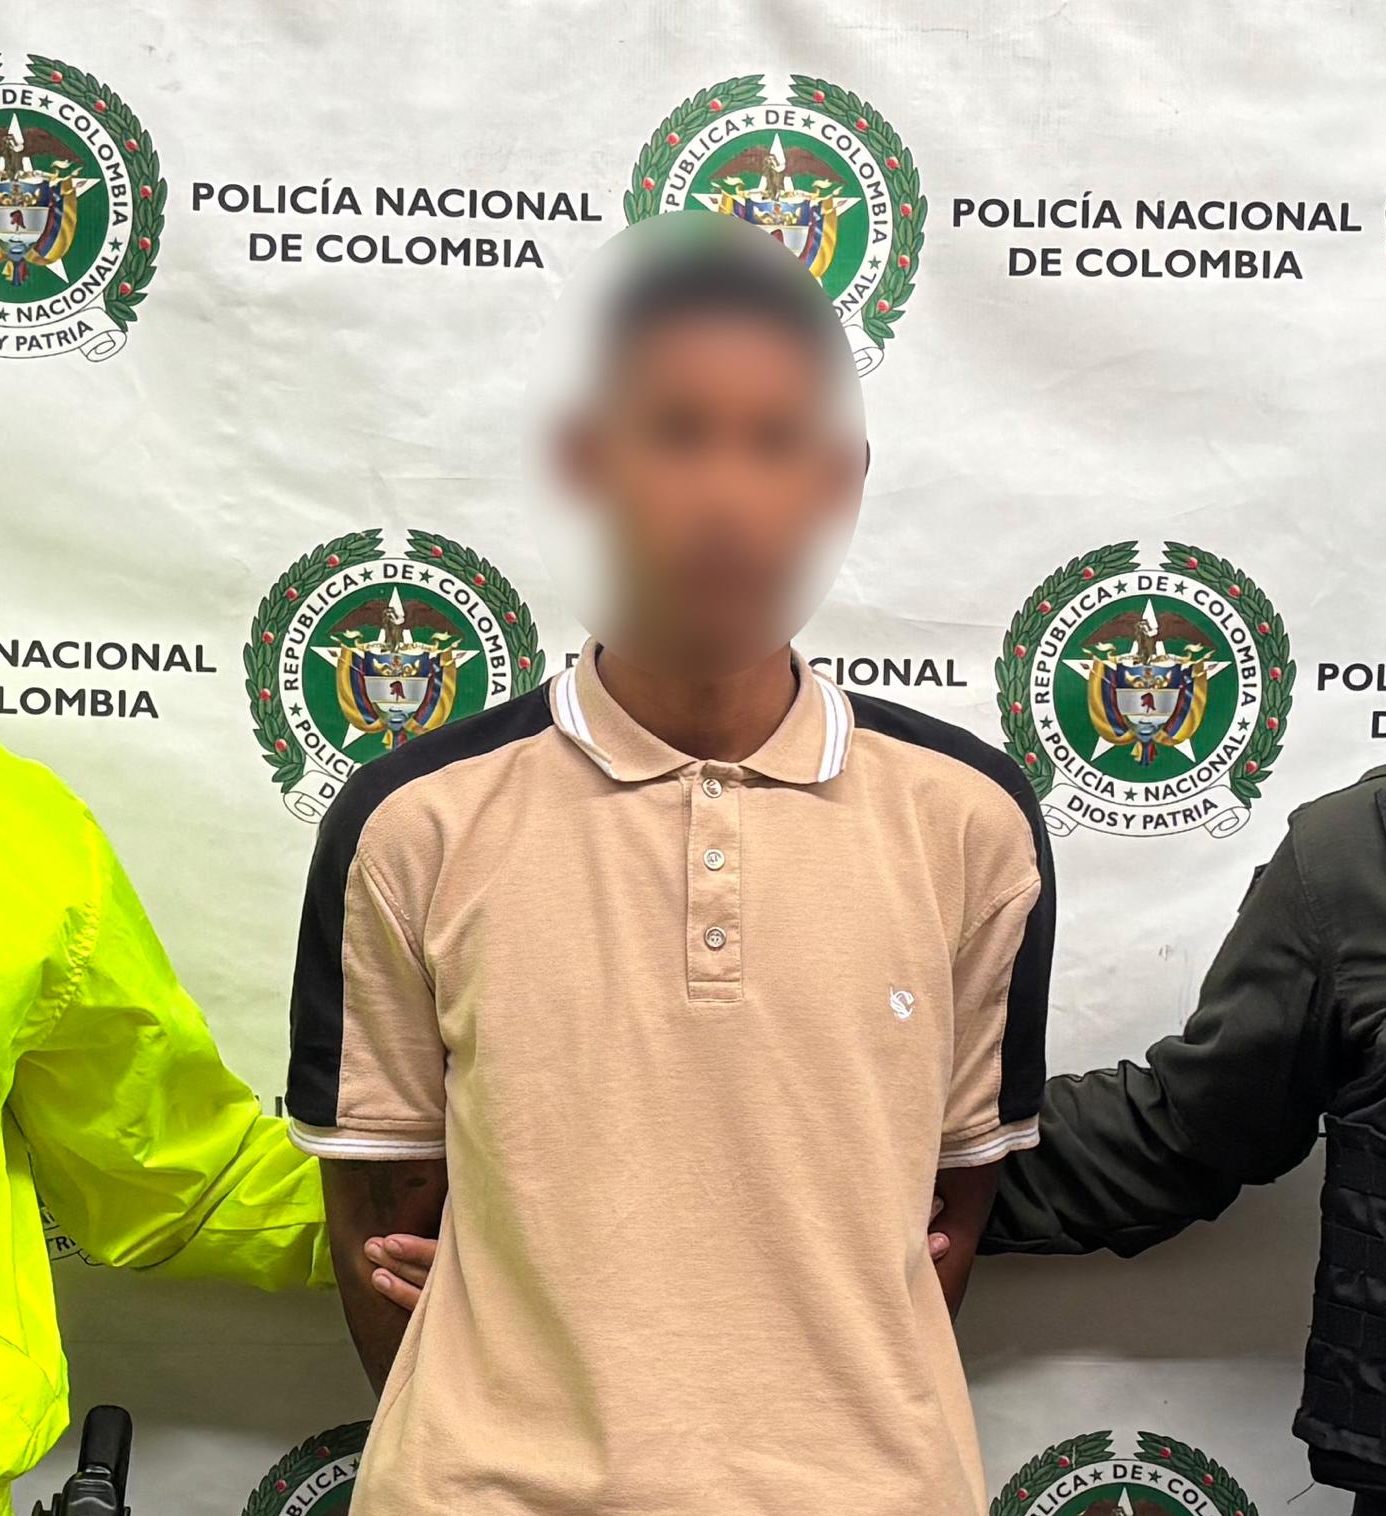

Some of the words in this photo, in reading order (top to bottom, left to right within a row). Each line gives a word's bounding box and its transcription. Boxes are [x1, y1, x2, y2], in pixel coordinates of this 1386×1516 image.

[2, 89, 33, 105] DE
[59, 104, 128, 226] COLOMBIA
[193, 178, 361, 215] POLICÍA
[376, 188, 602, 221] NACIONAL
[954, 191, 1121, 228] POLICÍA
[1136, 200, 1361, 231] NACIONAL
[250, 233, 302, 261] DE
[317, 235, 543, 268] COLOMBIA
[1009, 248, 1061, 276] DE
[1076, 249, 1302, 279] COLOMBIA
[17, 255, 119, 323] NACIONAL
[16, 321, 93, 351] PATRIA
[384, 564, 414, 580] DE
[439, 579, 506, 695] COLOMBIA
[1138, 576, 1168, 591] DE
[1194, 590, 1257, 706] COLOMBIA
[1145, 735, 1245, 801] NACIONAL
[1067, 795, 1118, 826] DIOS
[1143, 799, 1218, 829] PATRIA
[1113, 1464, 1143, 1480] DE
